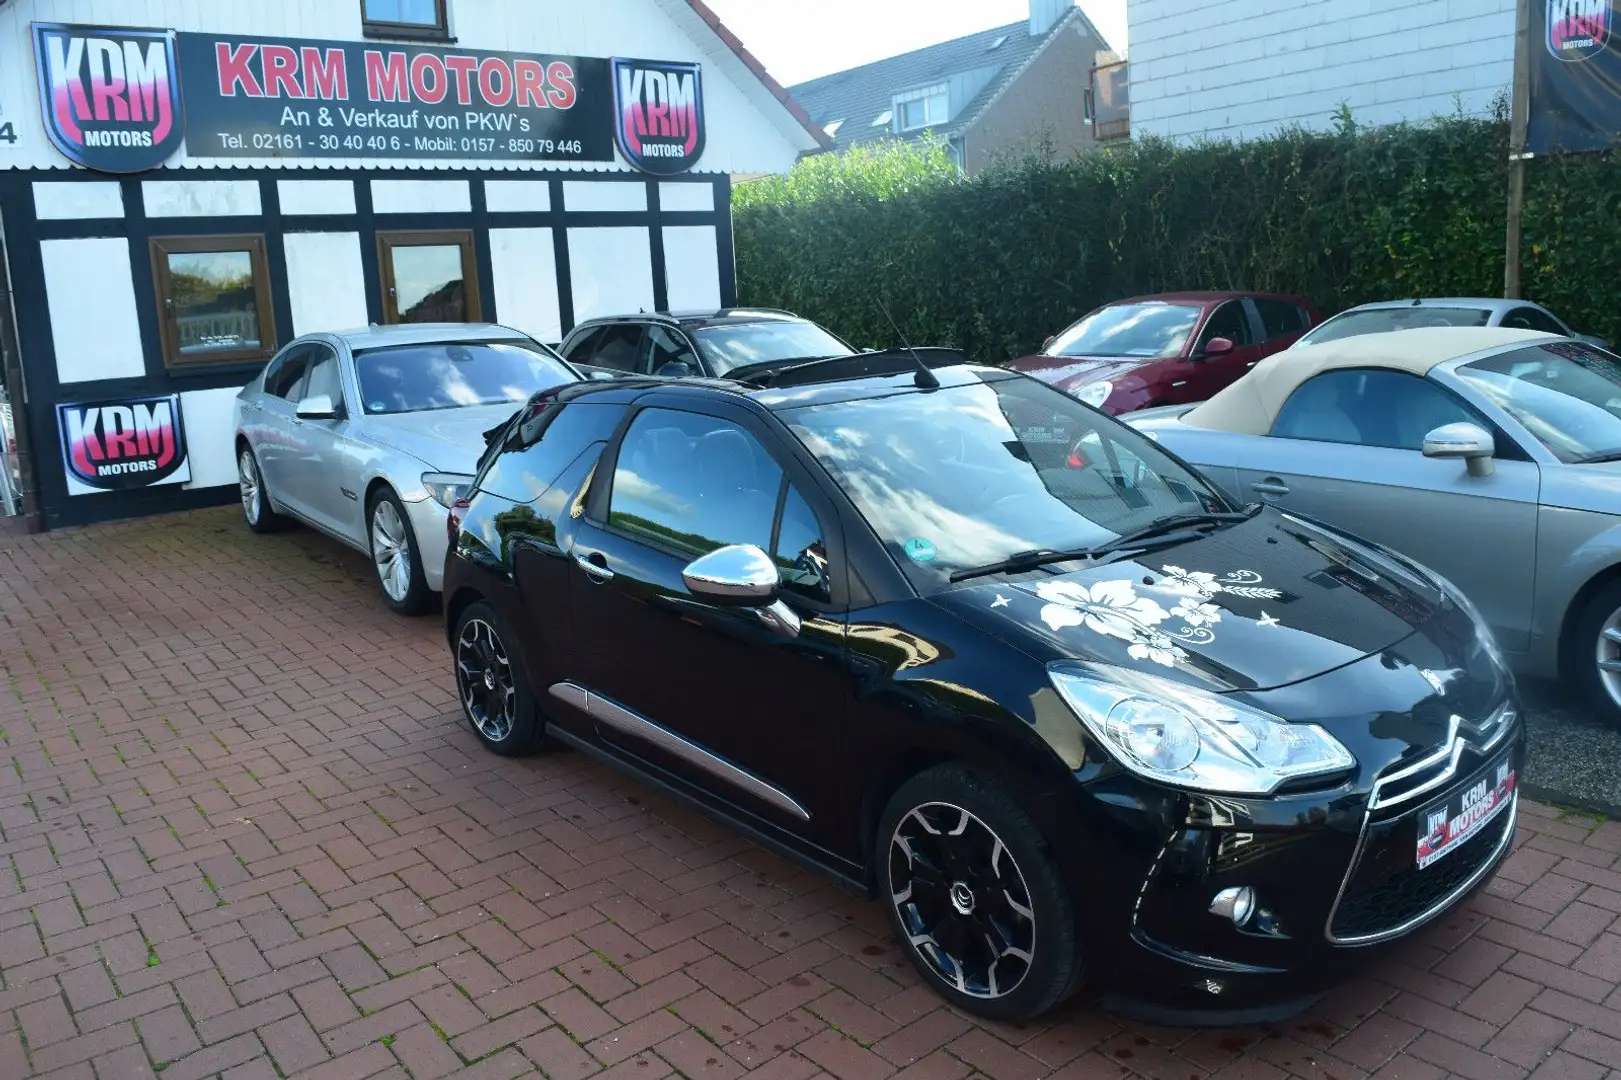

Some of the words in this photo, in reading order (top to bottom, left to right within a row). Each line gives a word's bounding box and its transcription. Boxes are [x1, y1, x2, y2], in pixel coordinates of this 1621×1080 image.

[1562, 38, 1594, 50] MOTORS
[215, 41, 350, 101] KRM
[363, 50, 577, 110] MOTORS
[47, 36, 173, 146] KRM
[280, 106, 310, 126] An
[317, 107, 334, 127] &
[338, 108, 419, 129] Verkauf
[423, 114, 459, 130] von
[620, 67, 698, 157] KRM
[84, 130, 153, 148] MOTORS
[217, 133, 248, 149] Tel.
[252, 133, 302, 149] 02161
[319, 134, 339, 150] 30
[343, 135, 363, 150] 40
[367, 136, 386, 150] 40
[390, 136, 401, 151] 6
[414, 136, 457, 151] Mobil:
[461, 138, 495, 152] 0157
[508, 139, 534, 153] 850
[537, 139, 554, 154] 79
[557, 140, 582, 154] 446
[642, 143, 685, 158] MOTORS
[66, 402, 175, 476] KRM
[97, 460, 157, 476] MOTORS
[1461, 778, 1487, 812] KRM
[1449, 789, 1495, 838] MOTORS
